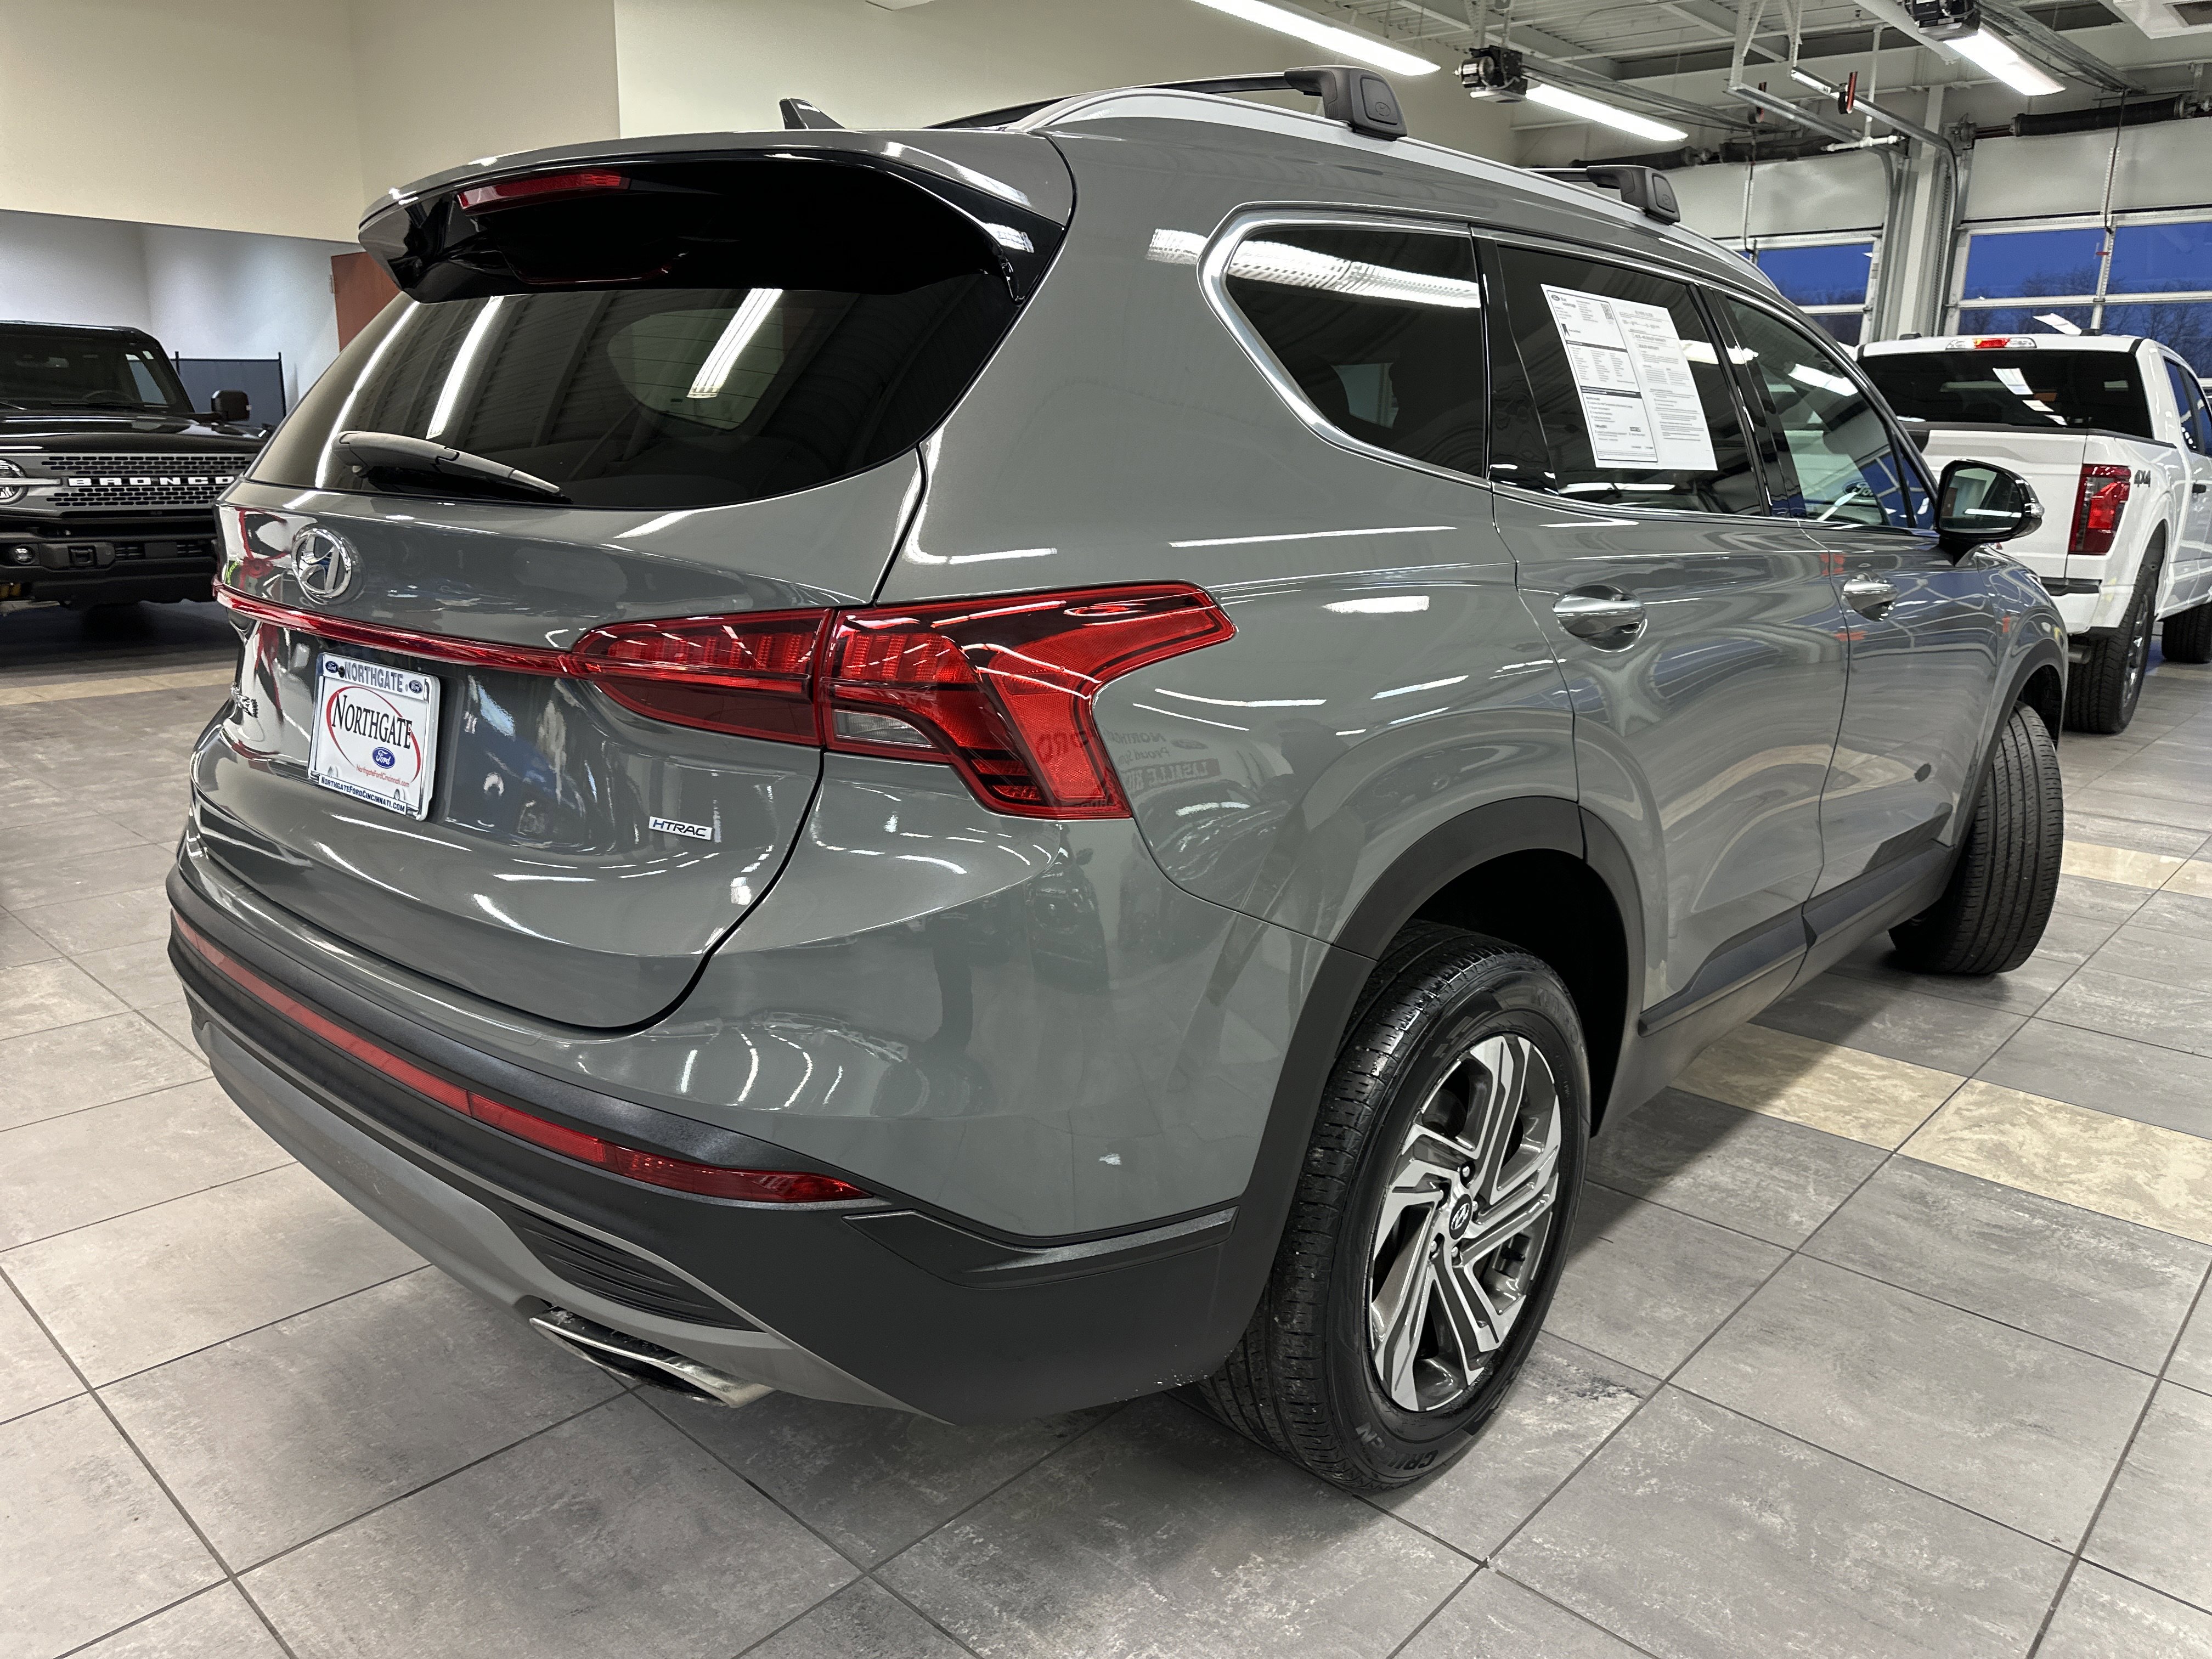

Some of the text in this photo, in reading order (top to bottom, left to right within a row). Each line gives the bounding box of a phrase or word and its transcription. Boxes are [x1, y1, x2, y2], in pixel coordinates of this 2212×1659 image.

[68, 476, 235, 487] BRONCO
[343, 661, 404, 693] NORTHGATE
[331, 693, 413, 749] NORTHGATE
[375, 749, 392, 765] Ford
[652, 819, 707, 837] HTRAC
